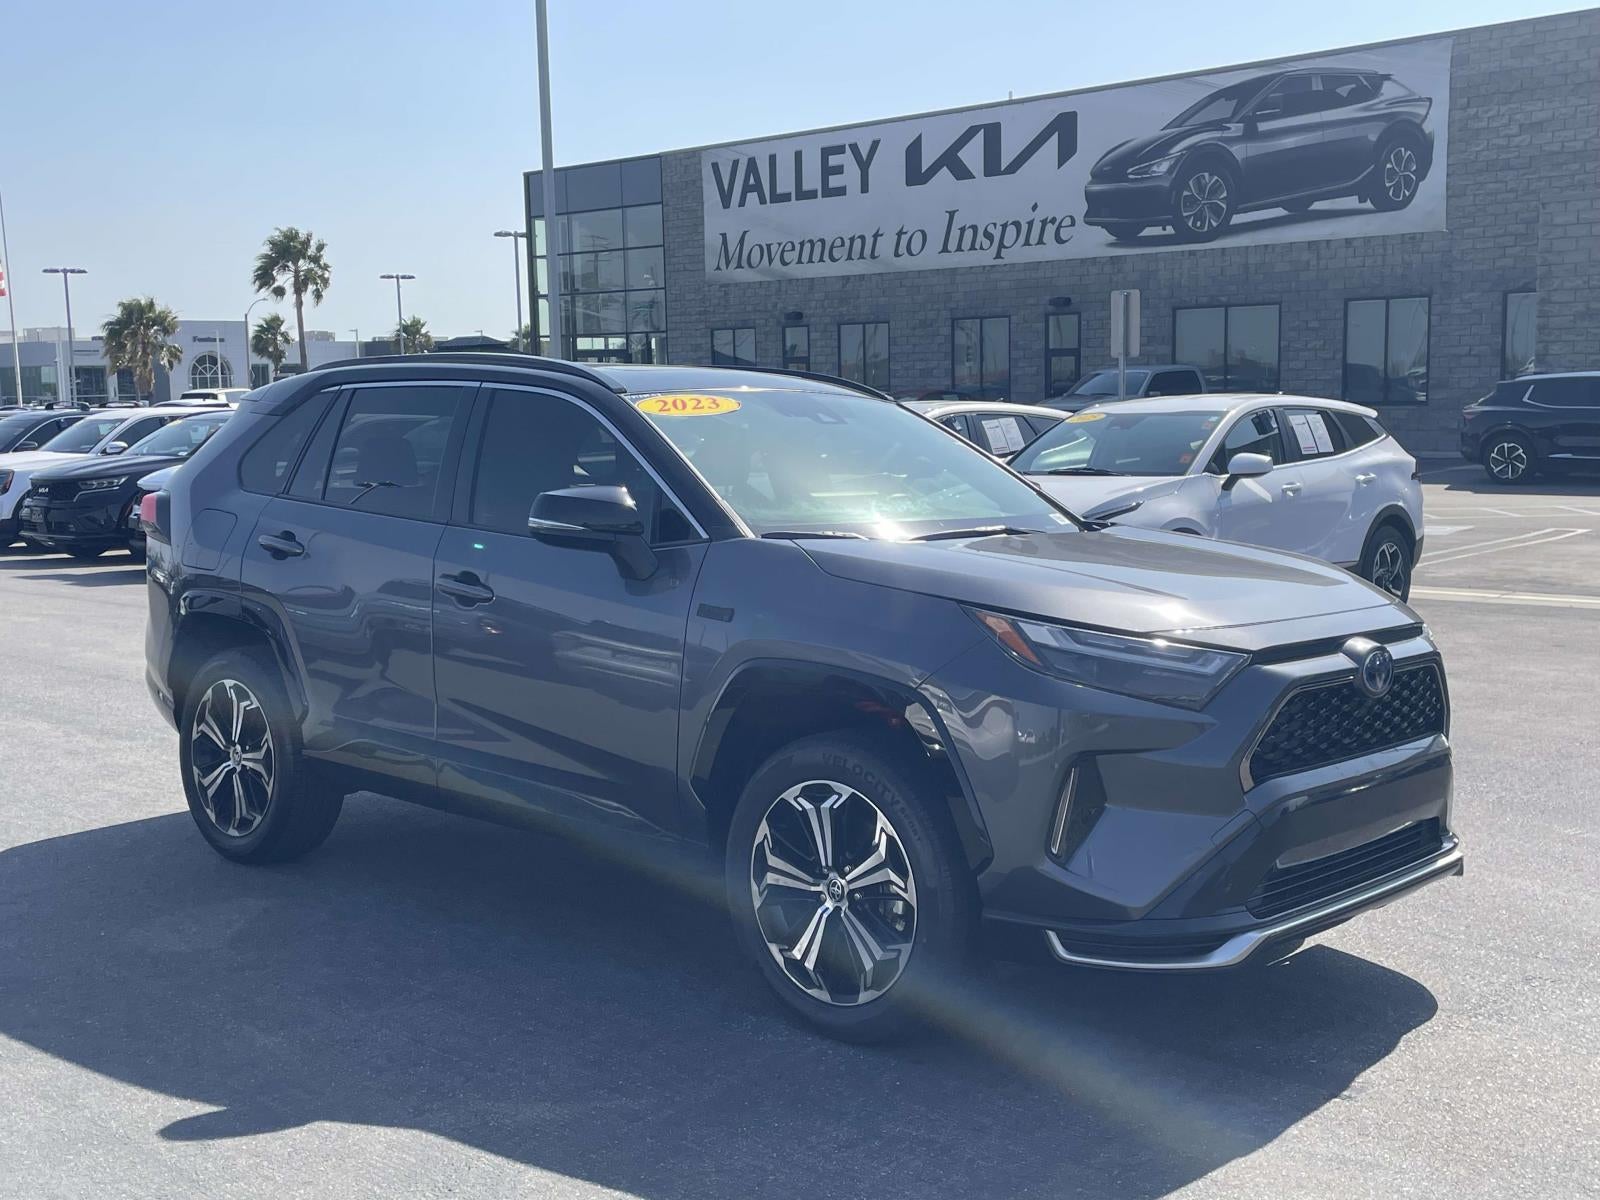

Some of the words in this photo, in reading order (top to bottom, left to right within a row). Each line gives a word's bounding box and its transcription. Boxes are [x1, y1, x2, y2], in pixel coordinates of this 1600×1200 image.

[711, 138, 881, 210] VALLEY
[905, 110, 1077, 187] KIA
[713, 227, 884, 272] Movement
[894, 223, 928, 258] to
[938, 202, 1077, 260] Inspire
[655, 397, 721, 412] 2023
